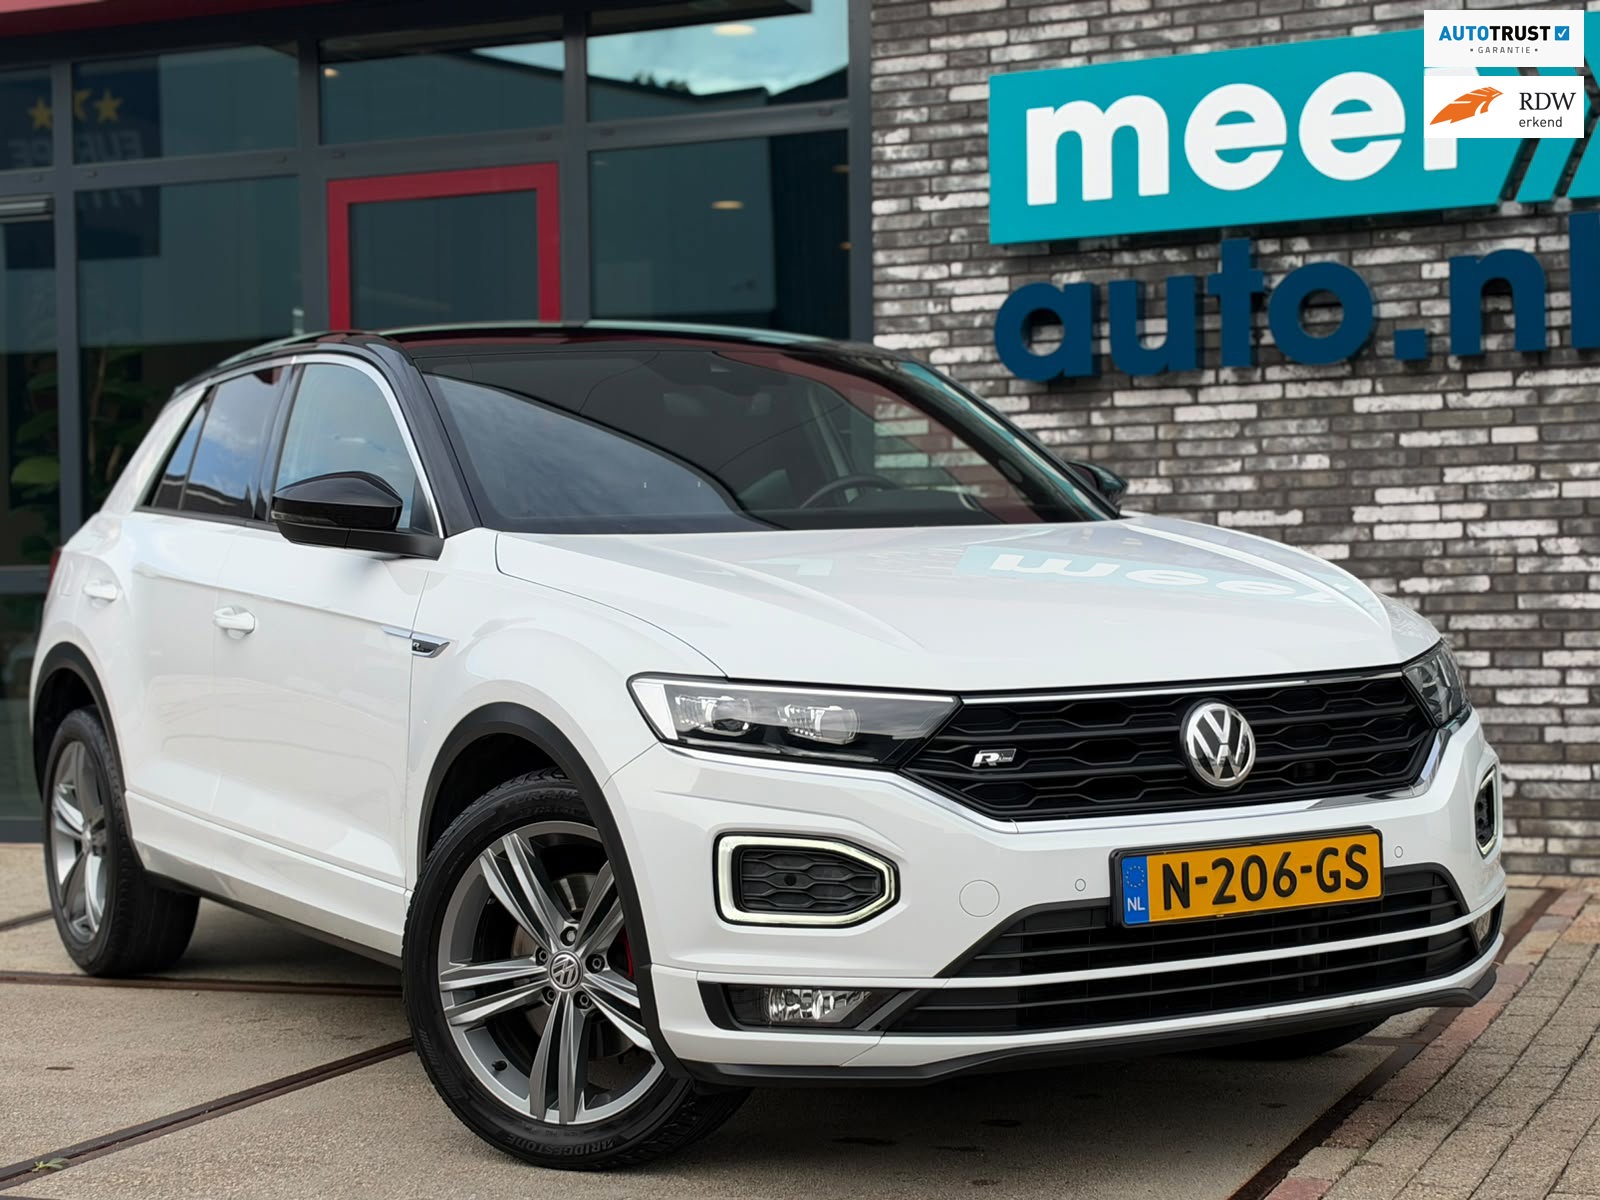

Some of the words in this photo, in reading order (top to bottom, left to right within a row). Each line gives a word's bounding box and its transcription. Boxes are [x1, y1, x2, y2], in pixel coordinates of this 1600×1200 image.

[994, 212, 1600, 382] auto.nl
[1127, 898, 1145, 911] NL
[1162, 844, 1369, 911] N-206-GS
